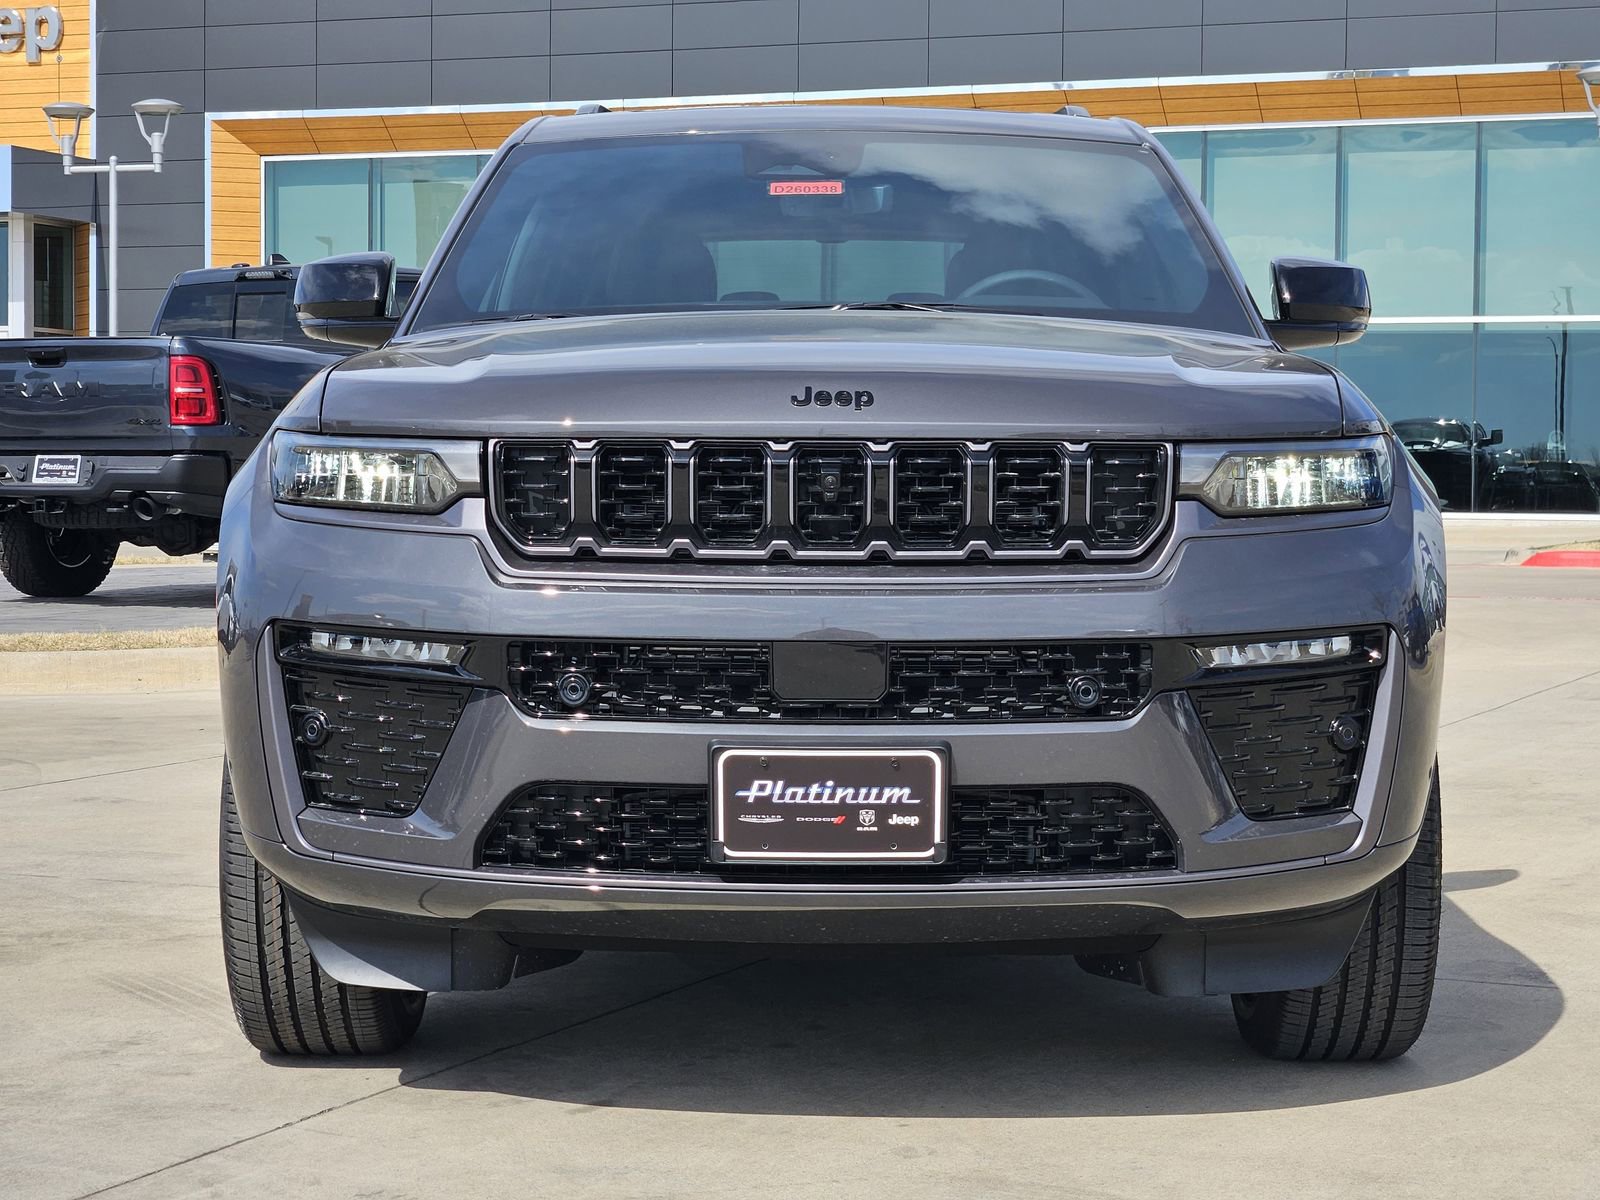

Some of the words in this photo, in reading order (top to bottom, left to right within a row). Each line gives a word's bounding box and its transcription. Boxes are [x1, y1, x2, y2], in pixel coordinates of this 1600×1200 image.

[774, 185, 838, 193] D260338
[790, 386, 875, 411] Jeep
[735, 780, 921, 804] Platinum
[888, 813, 920, 827] Jeep
